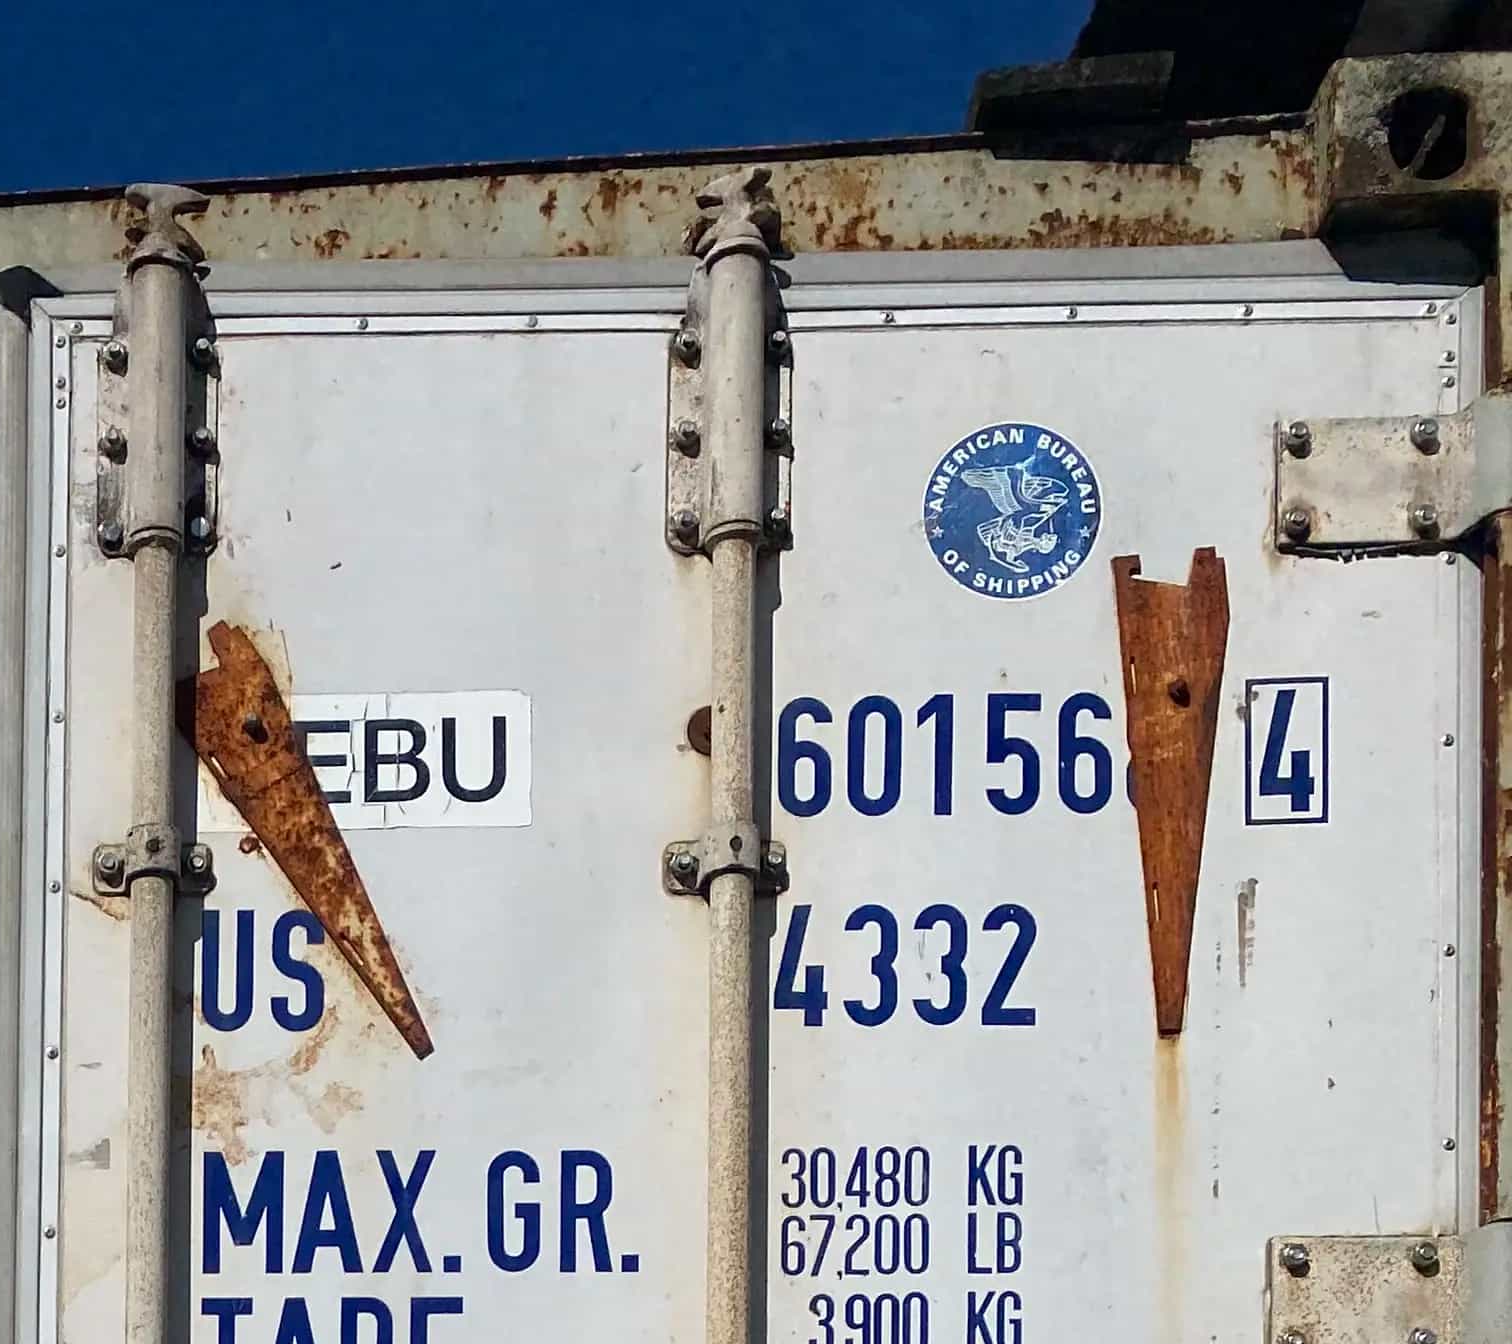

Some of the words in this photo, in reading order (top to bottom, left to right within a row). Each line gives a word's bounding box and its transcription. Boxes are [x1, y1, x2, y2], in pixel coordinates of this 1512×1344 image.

[929, 428, 1025, 512] AMERICAN
[1036, 432, 1096, 514] BUREAU
[942, 549, 970, 575] OF
[972, 549, 1082, 594] SHIPPING
[292, 714, 508, 805] EBU
[776, 691, 1139, 817] 60156
[1257, 688, 1316, 814] 4
[200, 908, 326, 1033] US
[772, 902, 1039, 1028] 4332
[780, 1145, 931, 1212] 30,480
[967, 1144, 1024, 1207] KG
[779, 1212, 930, 1281] 67,200
[967, 1211, 1023, 1275] LB
